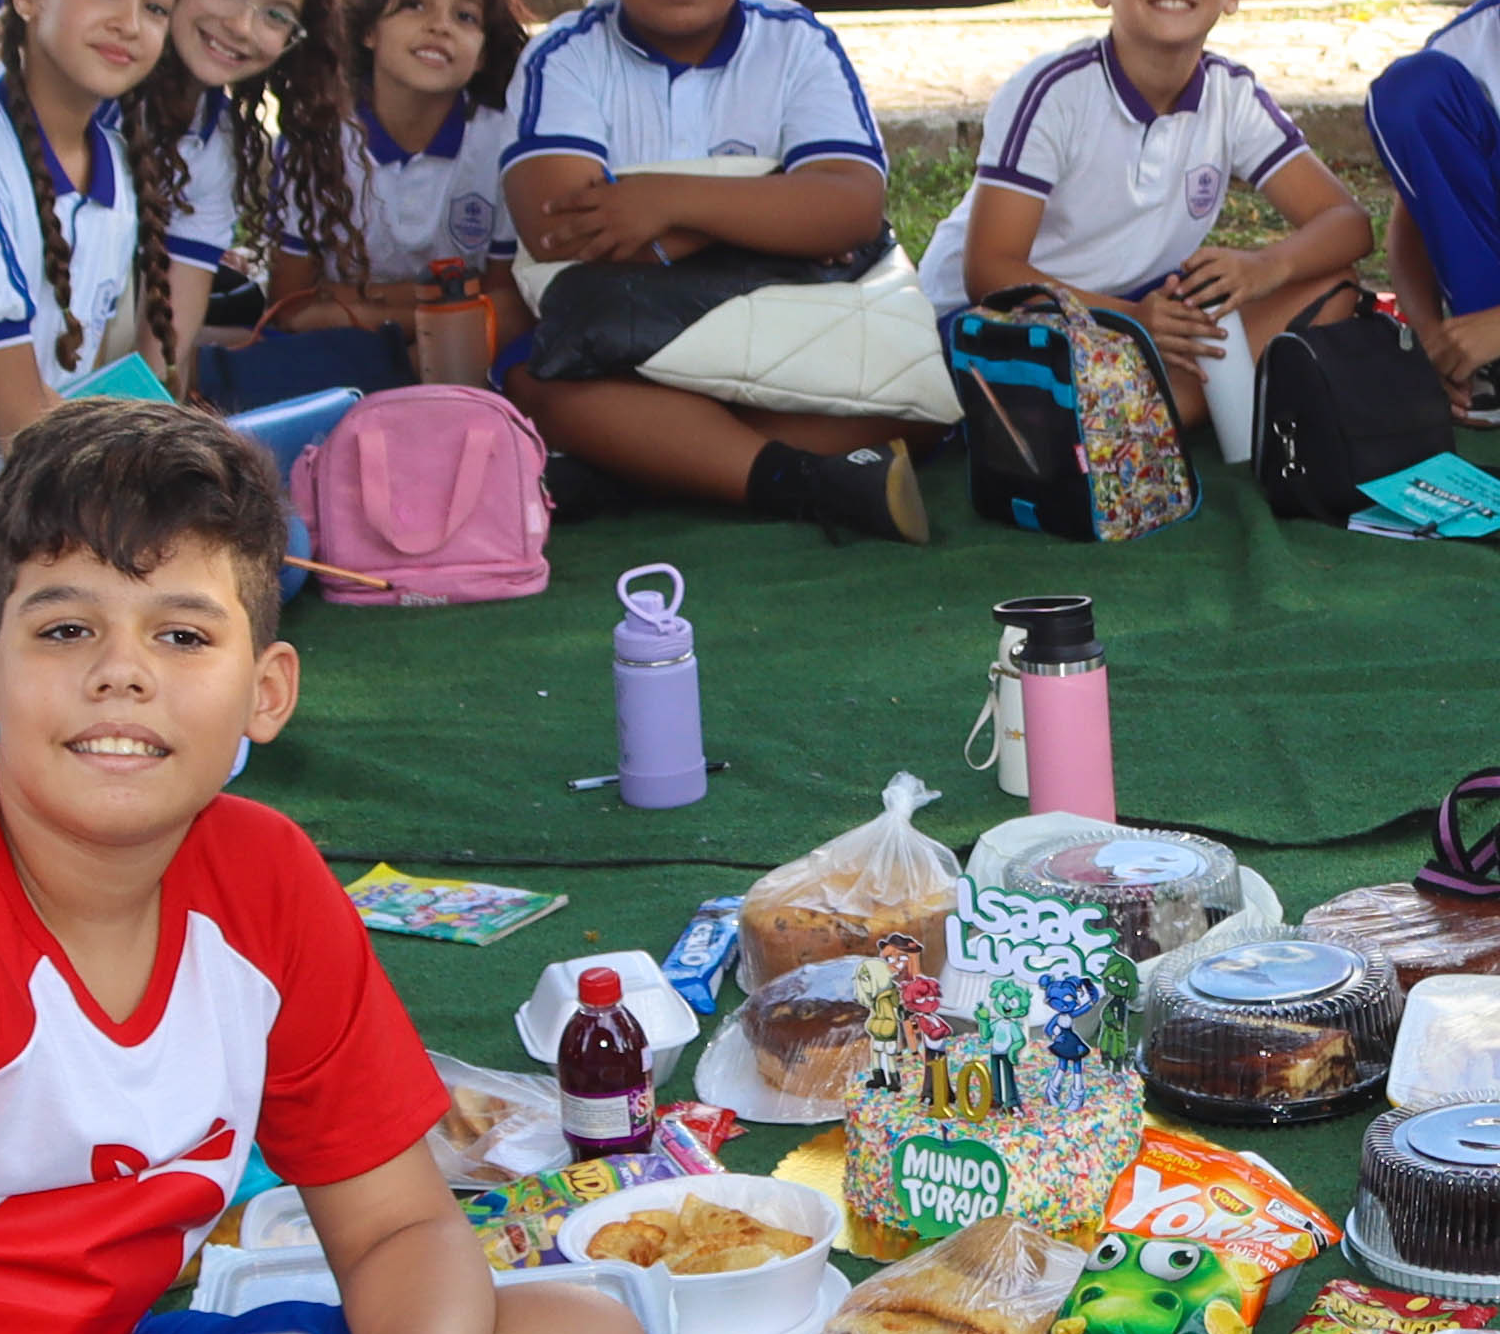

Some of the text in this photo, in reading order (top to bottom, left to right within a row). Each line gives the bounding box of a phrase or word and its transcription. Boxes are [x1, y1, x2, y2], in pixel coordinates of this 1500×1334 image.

[956, 874, 1113, 947] Isaac
[926, 1057, 993, 1123] 10
[902, 1143, 1001, 1194] MUNDO
[901, 1179, 999, 1227] TORAJO
[1213, 1188, 1244, 1213] YOKI
